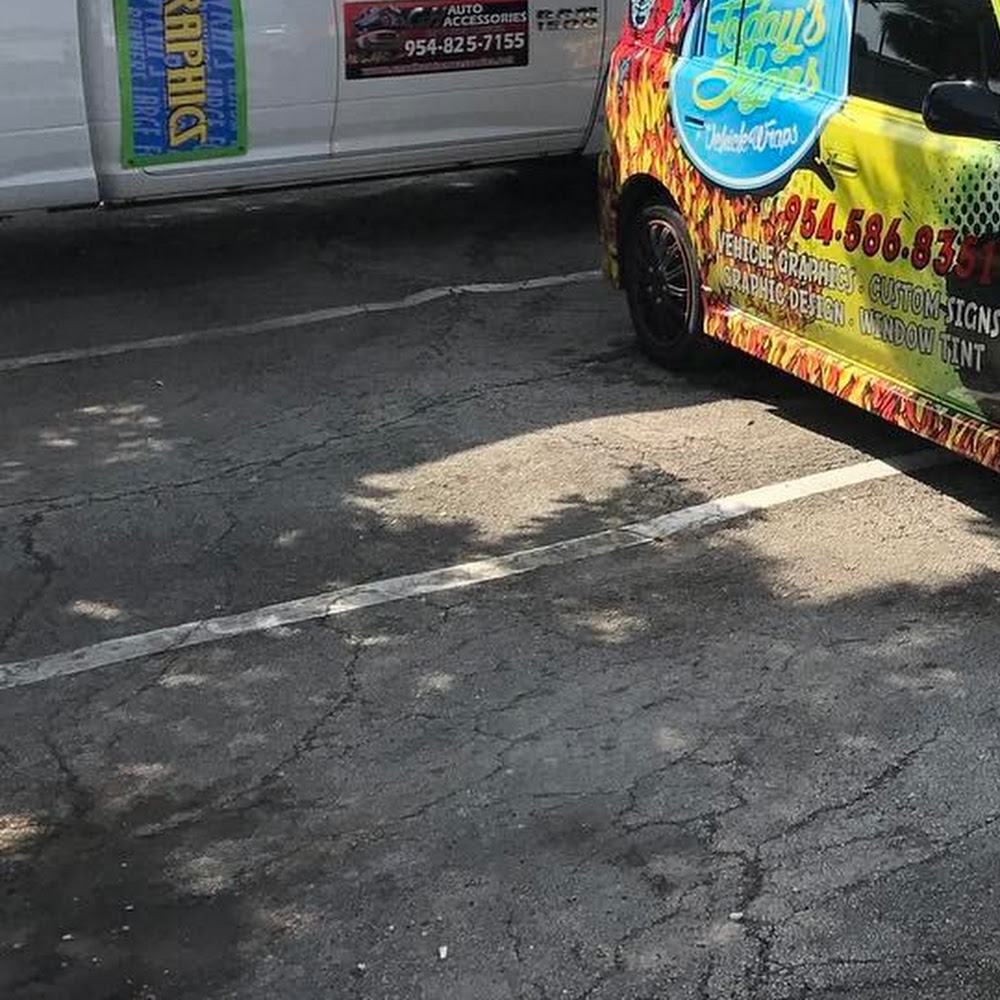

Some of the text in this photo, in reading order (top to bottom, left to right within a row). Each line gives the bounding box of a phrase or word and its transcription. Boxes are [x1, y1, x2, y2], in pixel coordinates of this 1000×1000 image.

[443, 11, 528, 28] ACCESSORIES
[447, 3, 483, 16] AUTO
[717, 229, 773, 269] VEHICLE
[778, 248, 855, 294] GRAPHICS
[869, 273, 940, 321] CUSTOM
[785, 193, 1000, 286] 954.586.8351
[724, 266, 987, 372] GRAPHIC DESIGN WINDOW TINT
